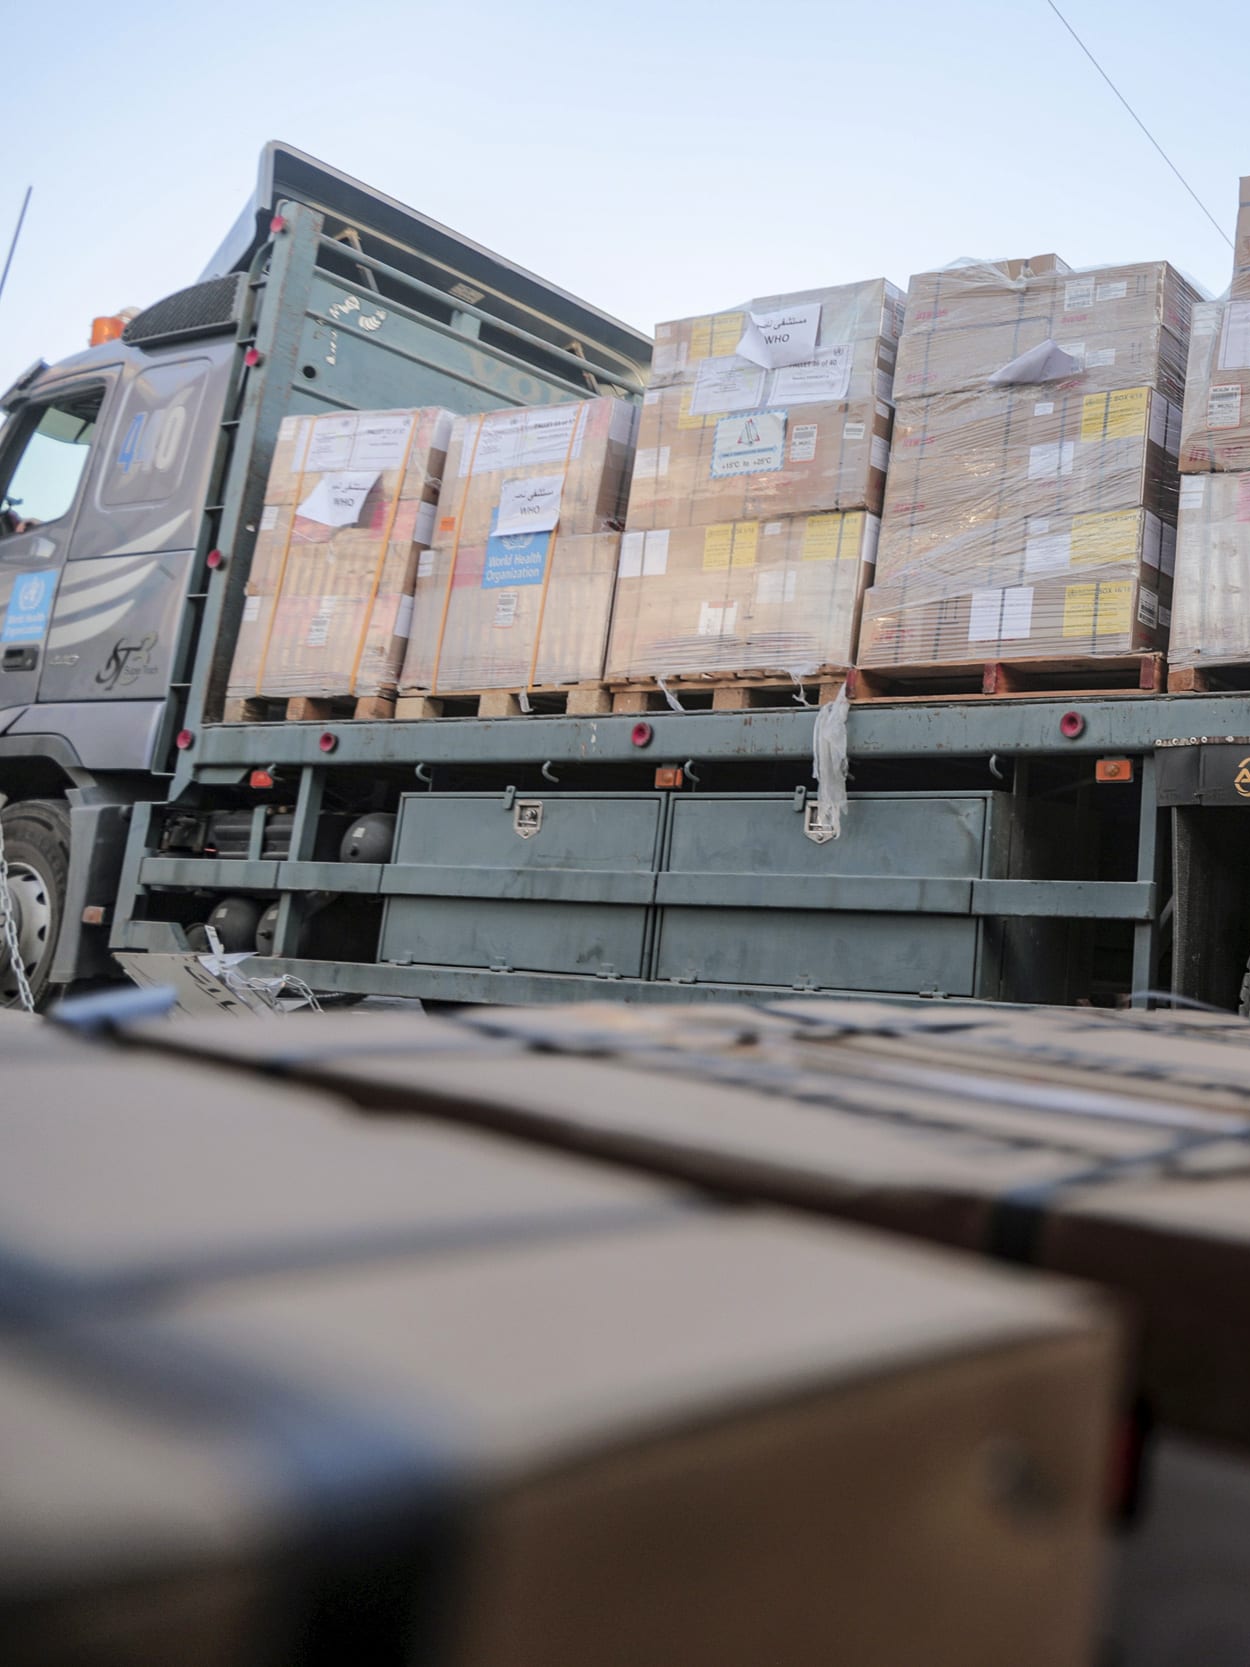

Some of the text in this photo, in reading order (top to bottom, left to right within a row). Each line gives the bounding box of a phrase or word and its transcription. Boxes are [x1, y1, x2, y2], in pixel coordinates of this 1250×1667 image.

[764, 334, 790, 345] WHO
[489, 552, 542, 567] World Health
[487, 567, 539, 583] Organization
